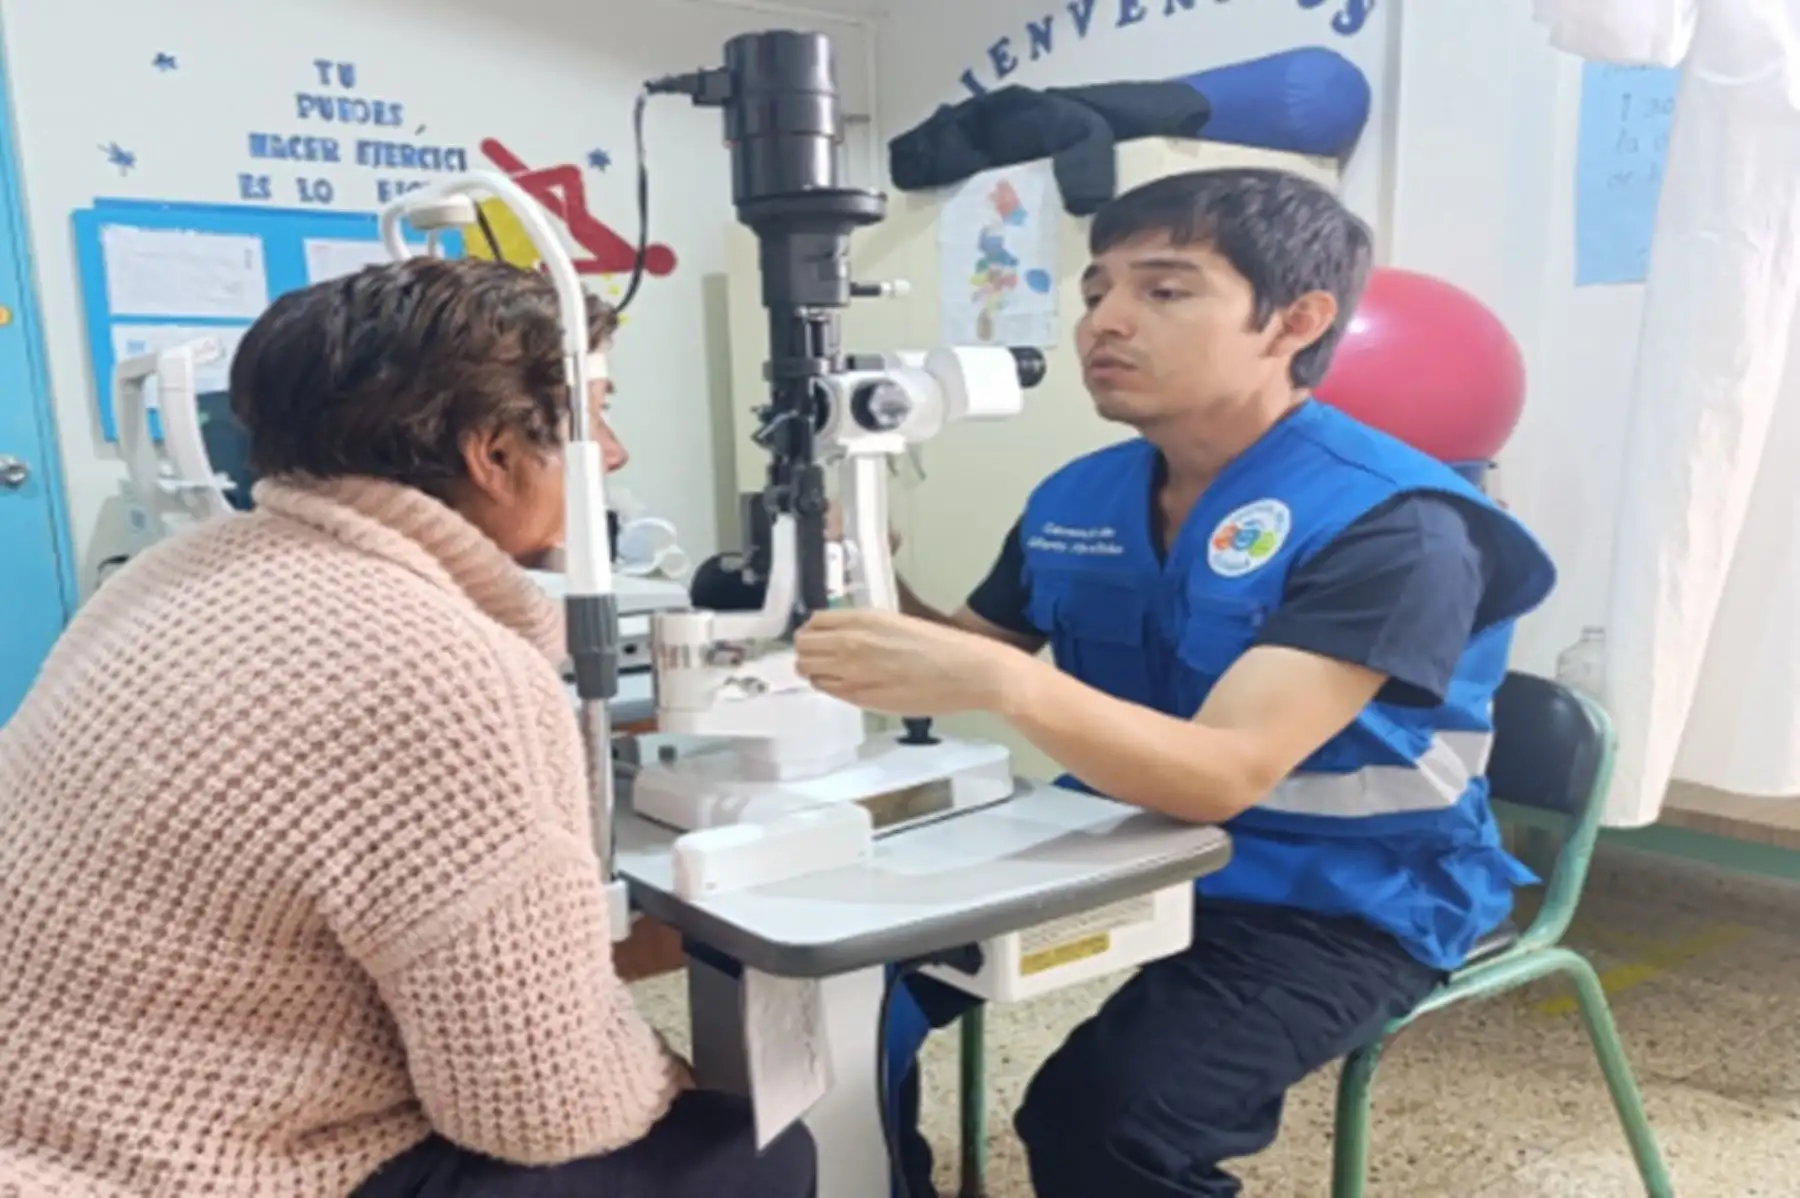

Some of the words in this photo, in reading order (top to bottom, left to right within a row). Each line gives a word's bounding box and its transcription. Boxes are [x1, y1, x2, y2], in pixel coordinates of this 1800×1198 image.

[313, 58, 356, 89] TU
[295, 92, 404, 127] PUEDES
[248, 132, 341, 163] HACER
[237, 172, 272, 201] ES
[296, 177, 335, 205] LO
